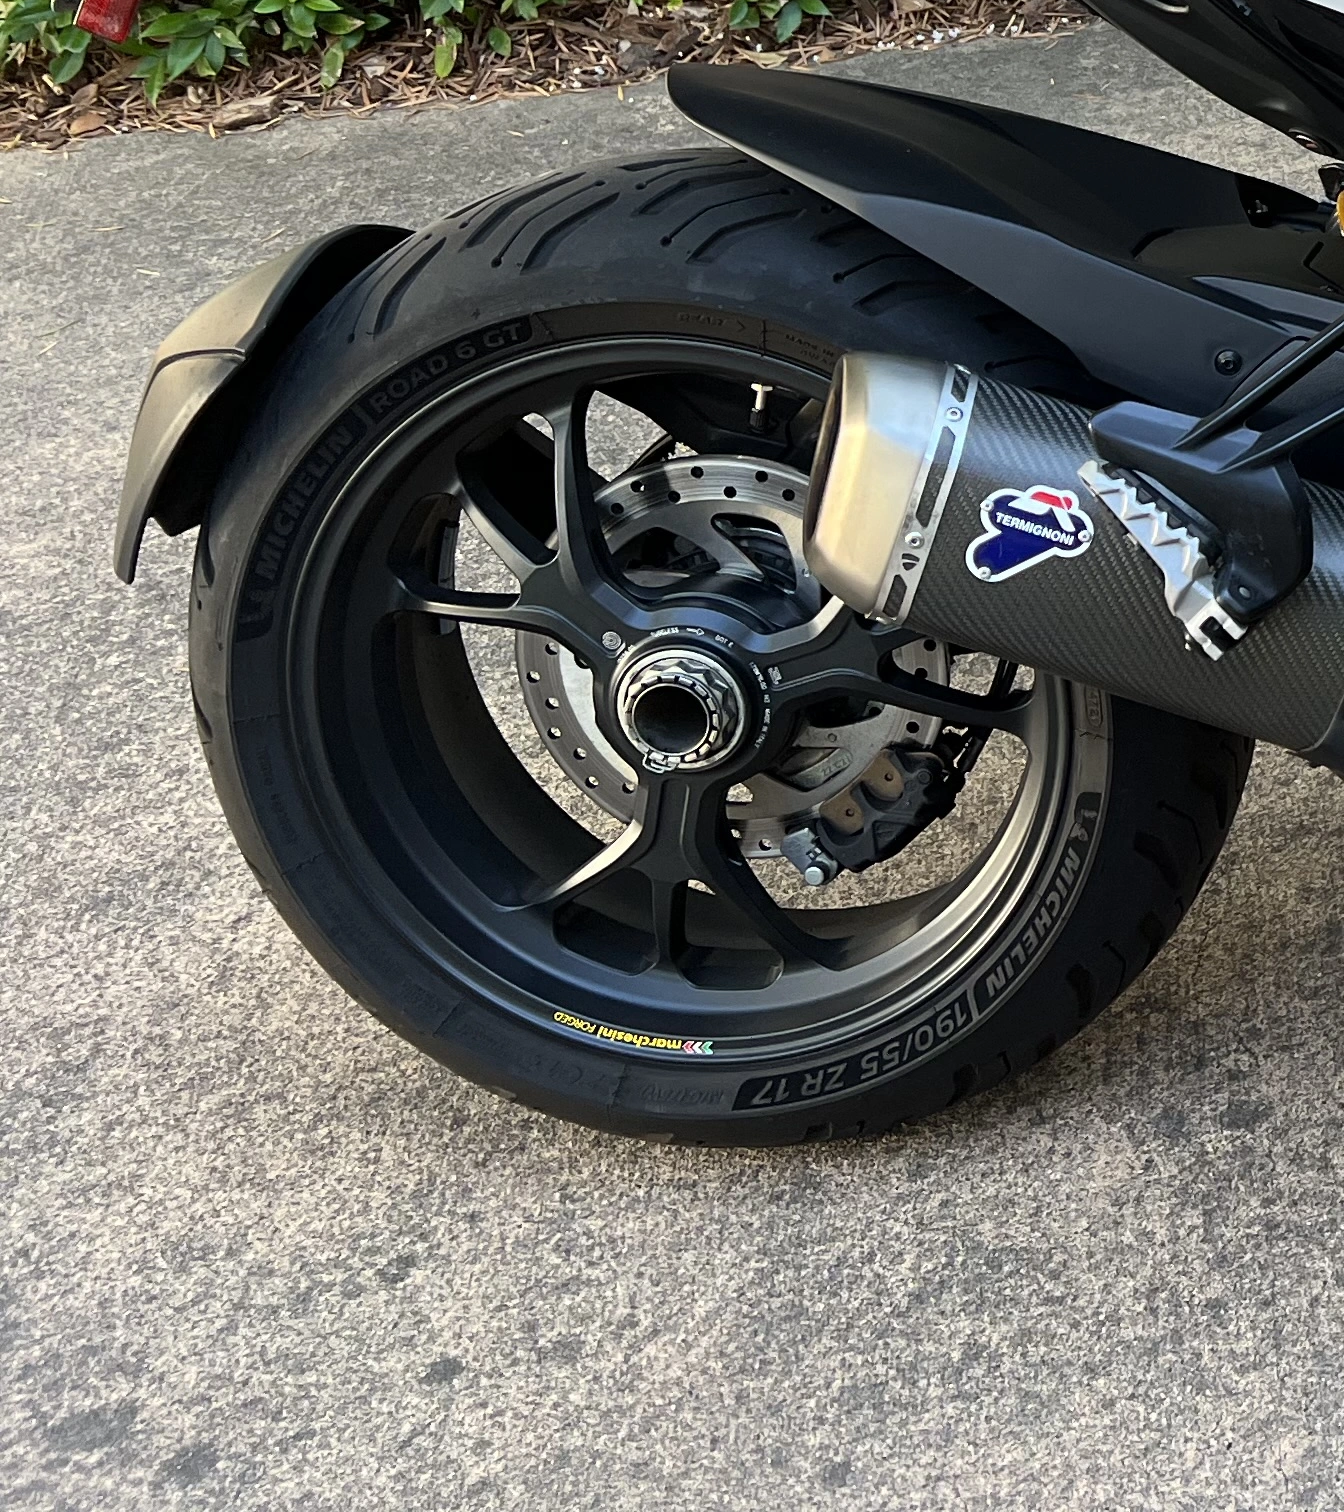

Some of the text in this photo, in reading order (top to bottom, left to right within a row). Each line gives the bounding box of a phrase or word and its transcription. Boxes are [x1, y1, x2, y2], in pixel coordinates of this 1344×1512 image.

[254, 323, 522, 583] MICHELIN ROAD 6 GT
[995, 511, 1075, 548] TERMIGNONI
[552, 1009, 683, 1052] marchesini FORGED
[751, 848, 1082, 1105] MICHELIN 190/55 ZR 17
